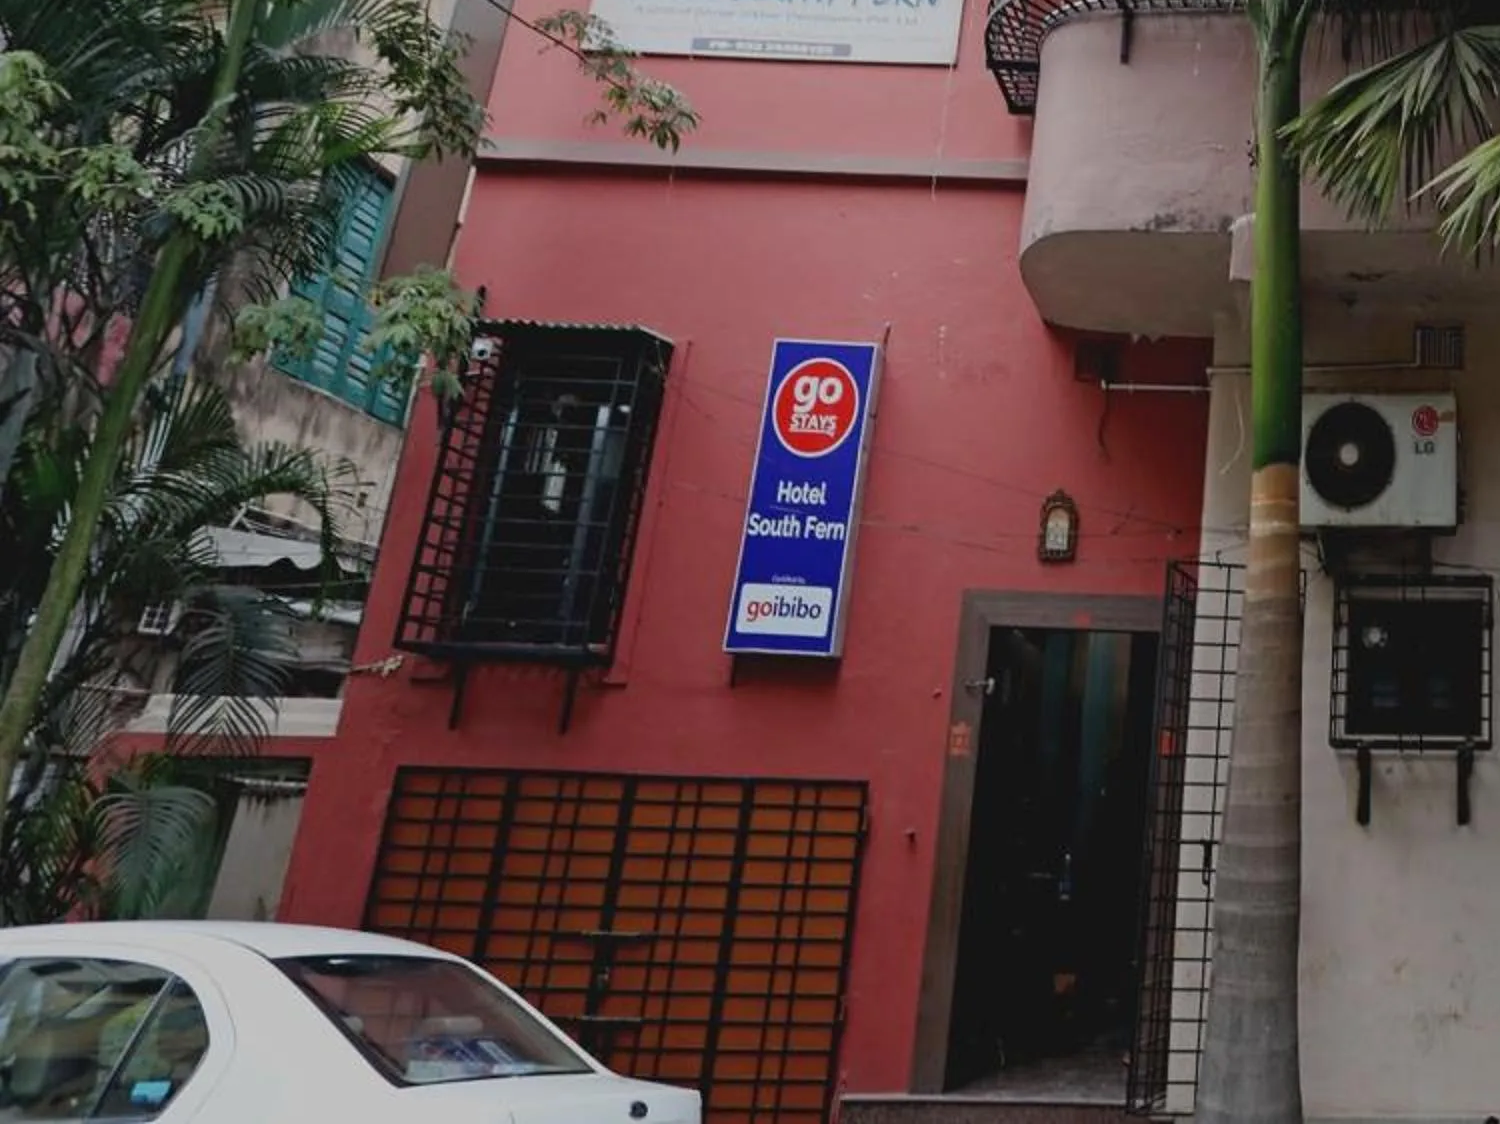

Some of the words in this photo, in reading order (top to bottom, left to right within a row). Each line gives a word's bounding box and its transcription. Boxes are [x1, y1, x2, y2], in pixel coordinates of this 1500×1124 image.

[794, 376, 843, 412] go
[789, 414, 839, 432] STAYS
[1414, 440, 1435, 454] LG
[777, 480, 826, 505] Hotel
[748, 513, 801, 538] South
[803, 516, 845, 540] Fern
[746, 596, 821, 622] goibibo
